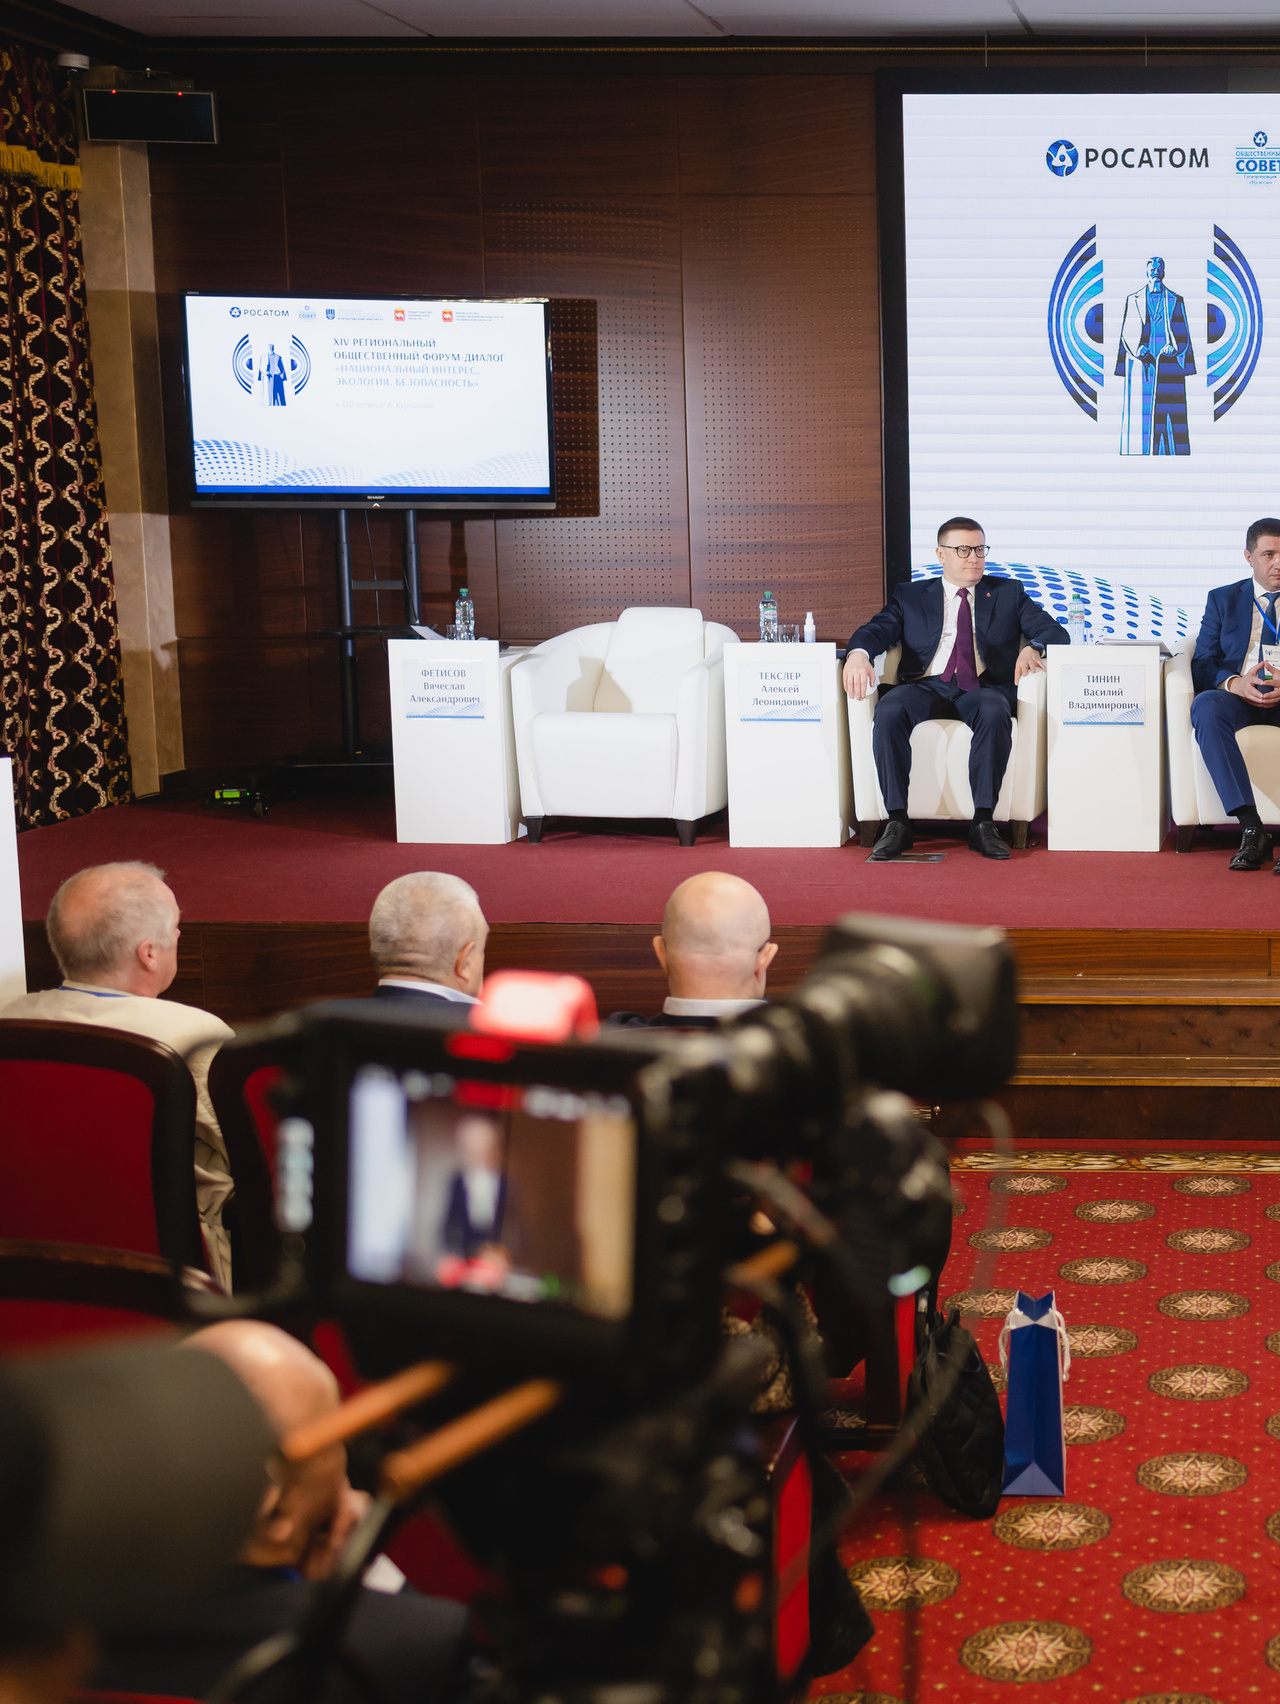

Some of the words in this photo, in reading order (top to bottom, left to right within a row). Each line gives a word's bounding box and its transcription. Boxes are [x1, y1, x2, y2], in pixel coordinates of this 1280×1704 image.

[1085, 147, 1210, 168] РОСАТОМ
[243, 309, 290, 317] РОСАТОМ
[333, 338, 350, 346] XIV
[352, 338, 436, 348] РЕГИОНАЛЬНЫЙ
[333, 351, 420, 361] ОБЩЕСТВЕННЫЙ
[422, 352, 505, 363] ФОРУМ-ДИАЛОГ
[335, 364, 429, 375] «НАЦИОНАЛЬНЫЙ
[431, 366, 479, 376] ИНТЕРЕС,
[335, 378, 393, 387] ЭКОЛОГИЯ,
[395, 378, 479, 388] БЕЗОПАСНОСТЬ»
[421, 669, 467, 678] ФЕТИСОВ
[759, 672, 801, 680] ТЕКСЛЕР
[1086, 675, 1121, 684] ТИНИН
[423, 682, 466, 690] Вячеслав
[761, 685, 799, 693] Алексей
[1083, 687, 1123, 697] Василий
[409, 694, 480, 705] Александрович
[752, 697, 809, 707] Леонидович
[1068, 700, 1139, 712] Владимирович
